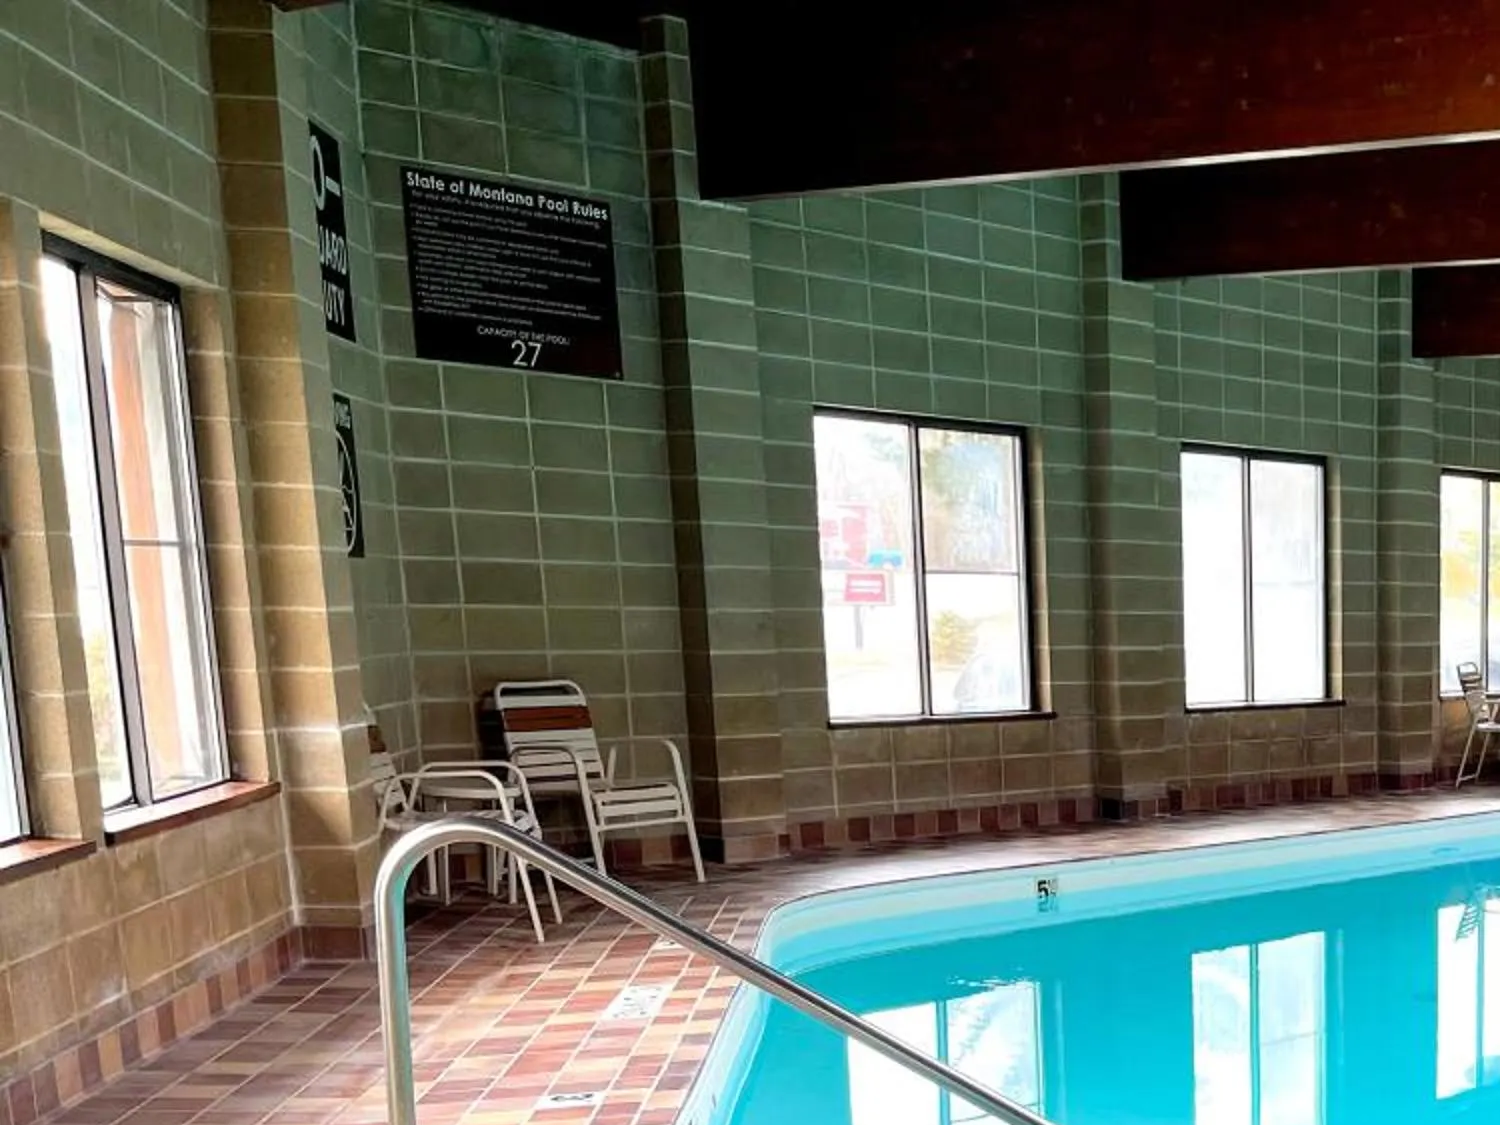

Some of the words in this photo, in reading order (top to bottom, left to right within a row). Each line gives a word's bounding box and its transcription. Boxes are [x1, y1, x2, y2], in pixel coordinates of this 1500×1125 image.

[406, 171, 445, 191] State
[451, 180, 465, 194] of
[469, 183, 535, 206] Montana
[538, 195, 569, 213] Pool
[572, 201, 609, 221] Rules
[511, 340, 542, 367] 27
[1037, 880, 1049, 899] 5
